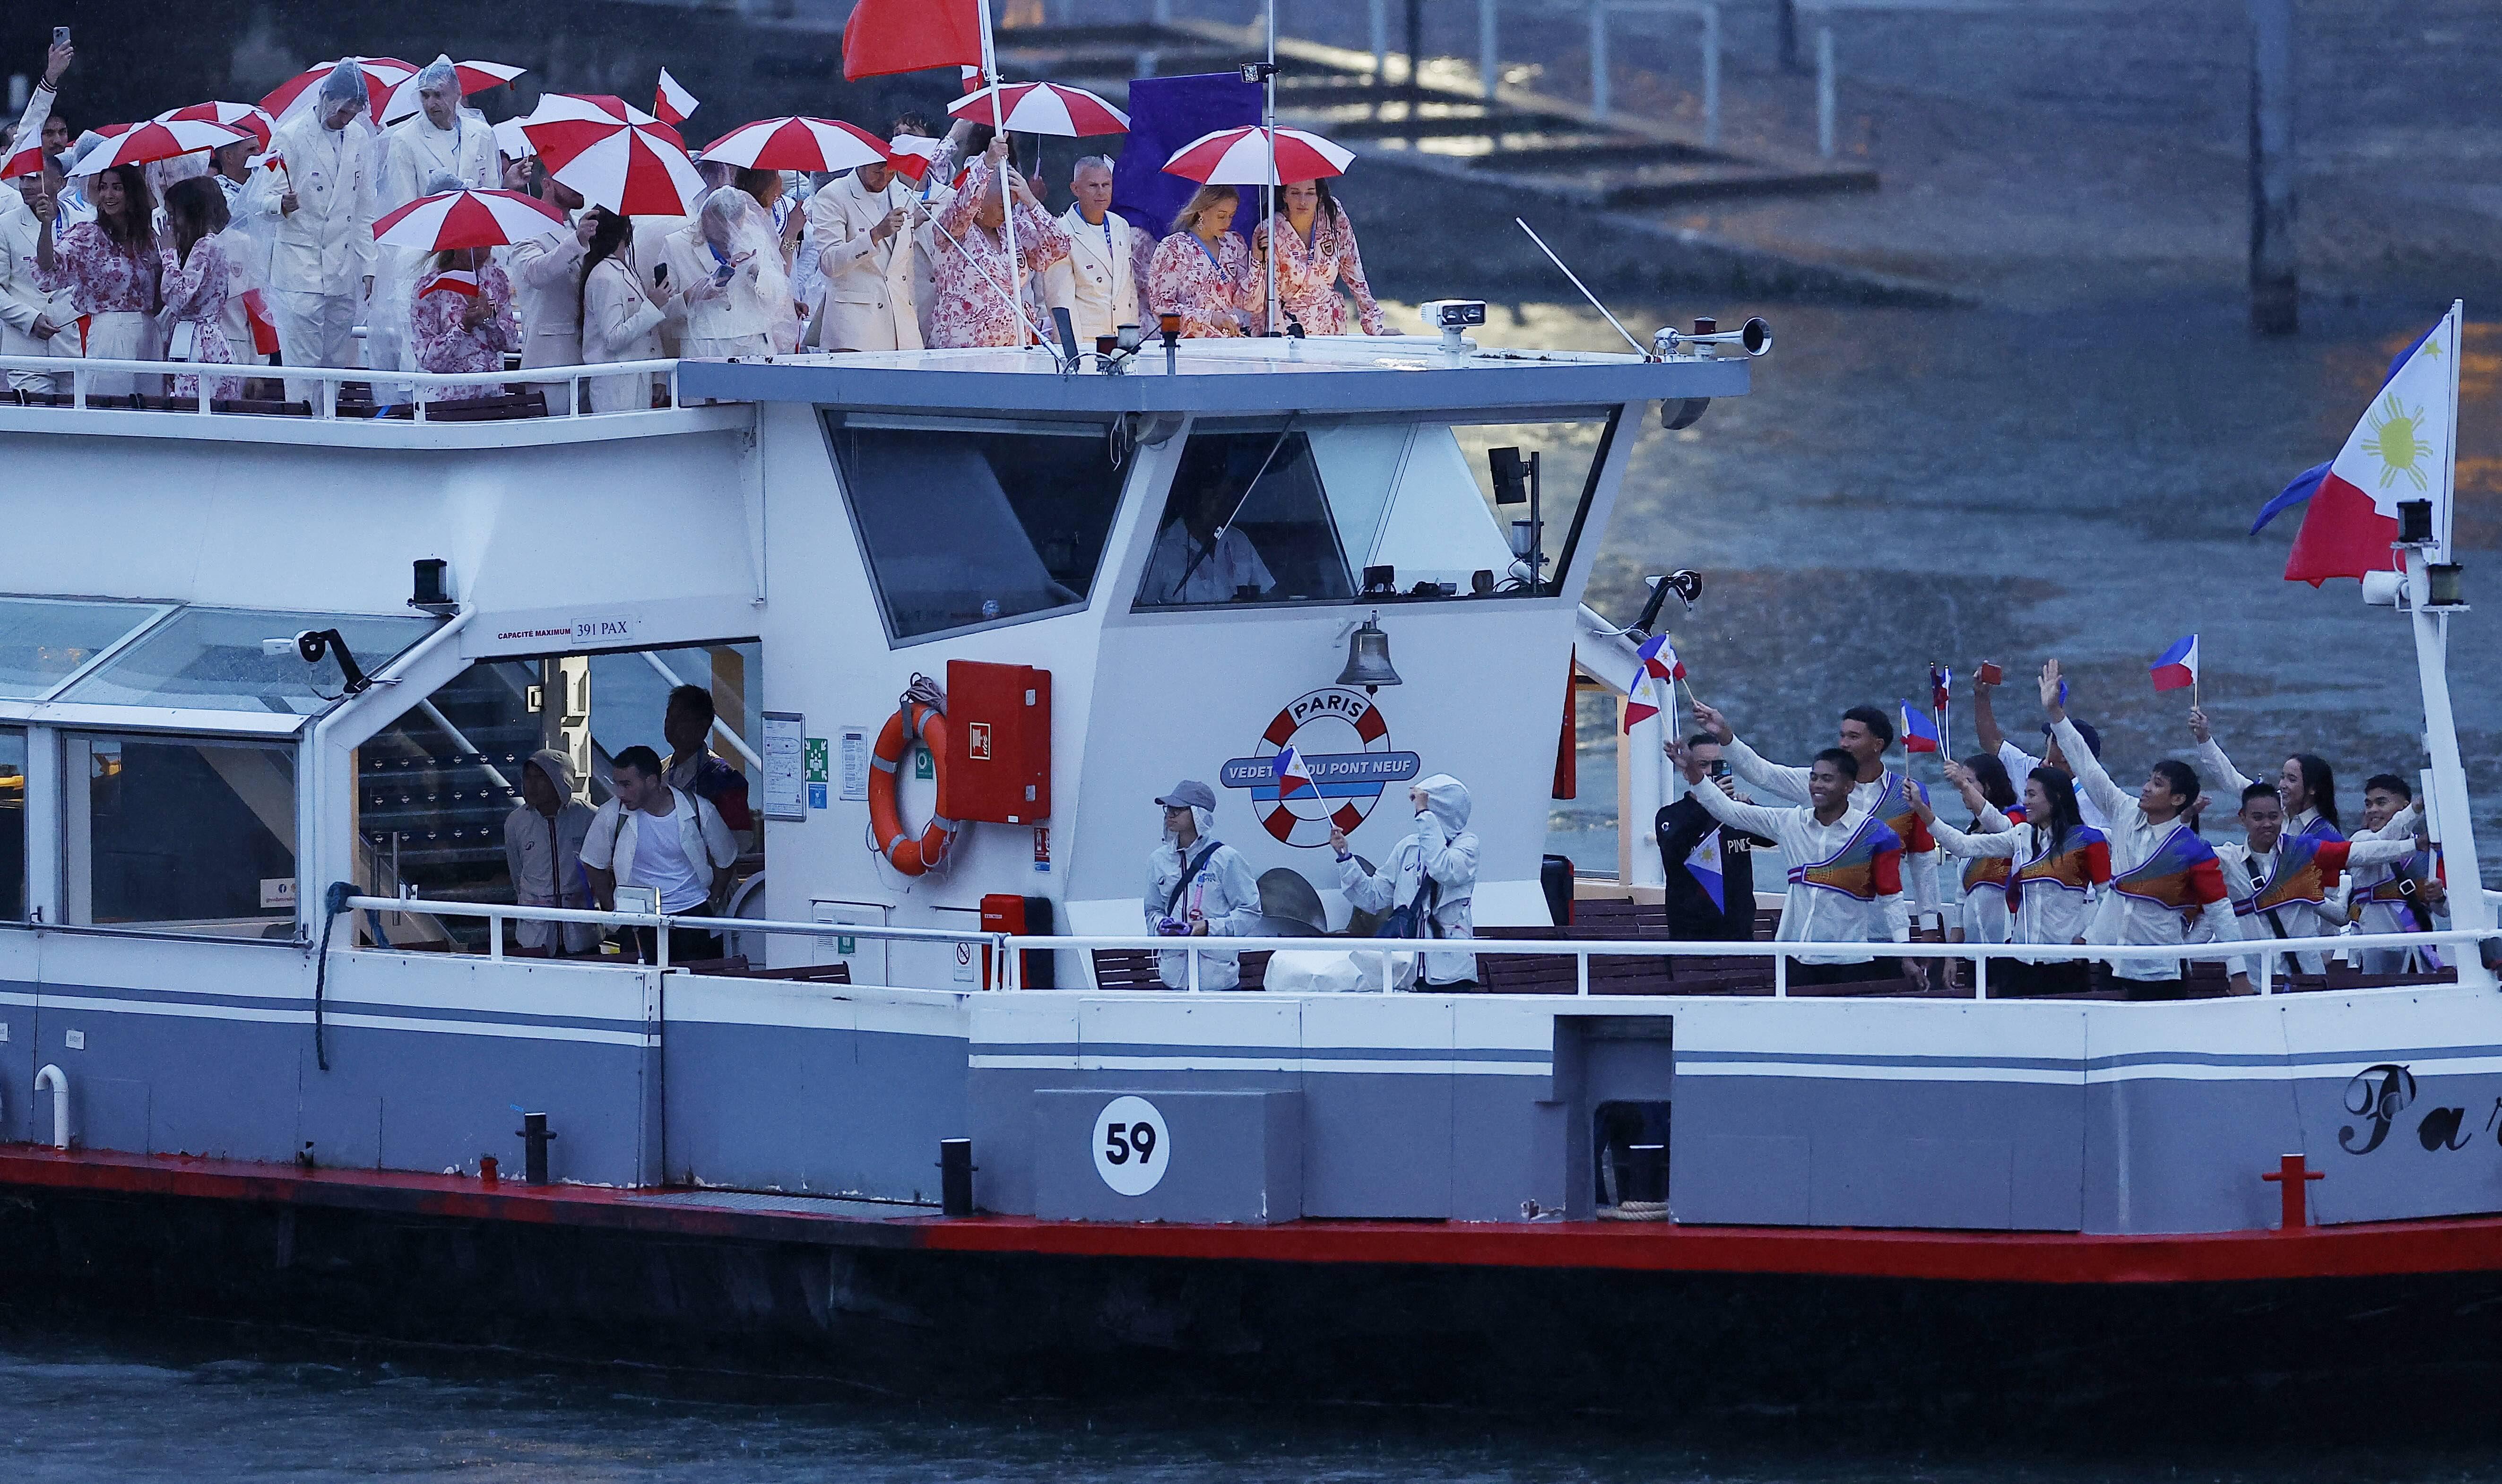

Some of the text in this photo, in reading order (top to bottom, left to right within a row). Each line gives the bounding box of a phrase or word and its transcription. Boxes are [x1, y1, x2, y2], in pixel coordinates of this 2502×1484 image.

[498, 621, 627, 639] CAPACITÉ MAXIMUM 391 PAX
[1293, 695, 1363, 720] PARIS
[1229, 759, 1411, 779] VEDET DU PONT NEUF
[1106, 1122, 1156, 1165] 59
